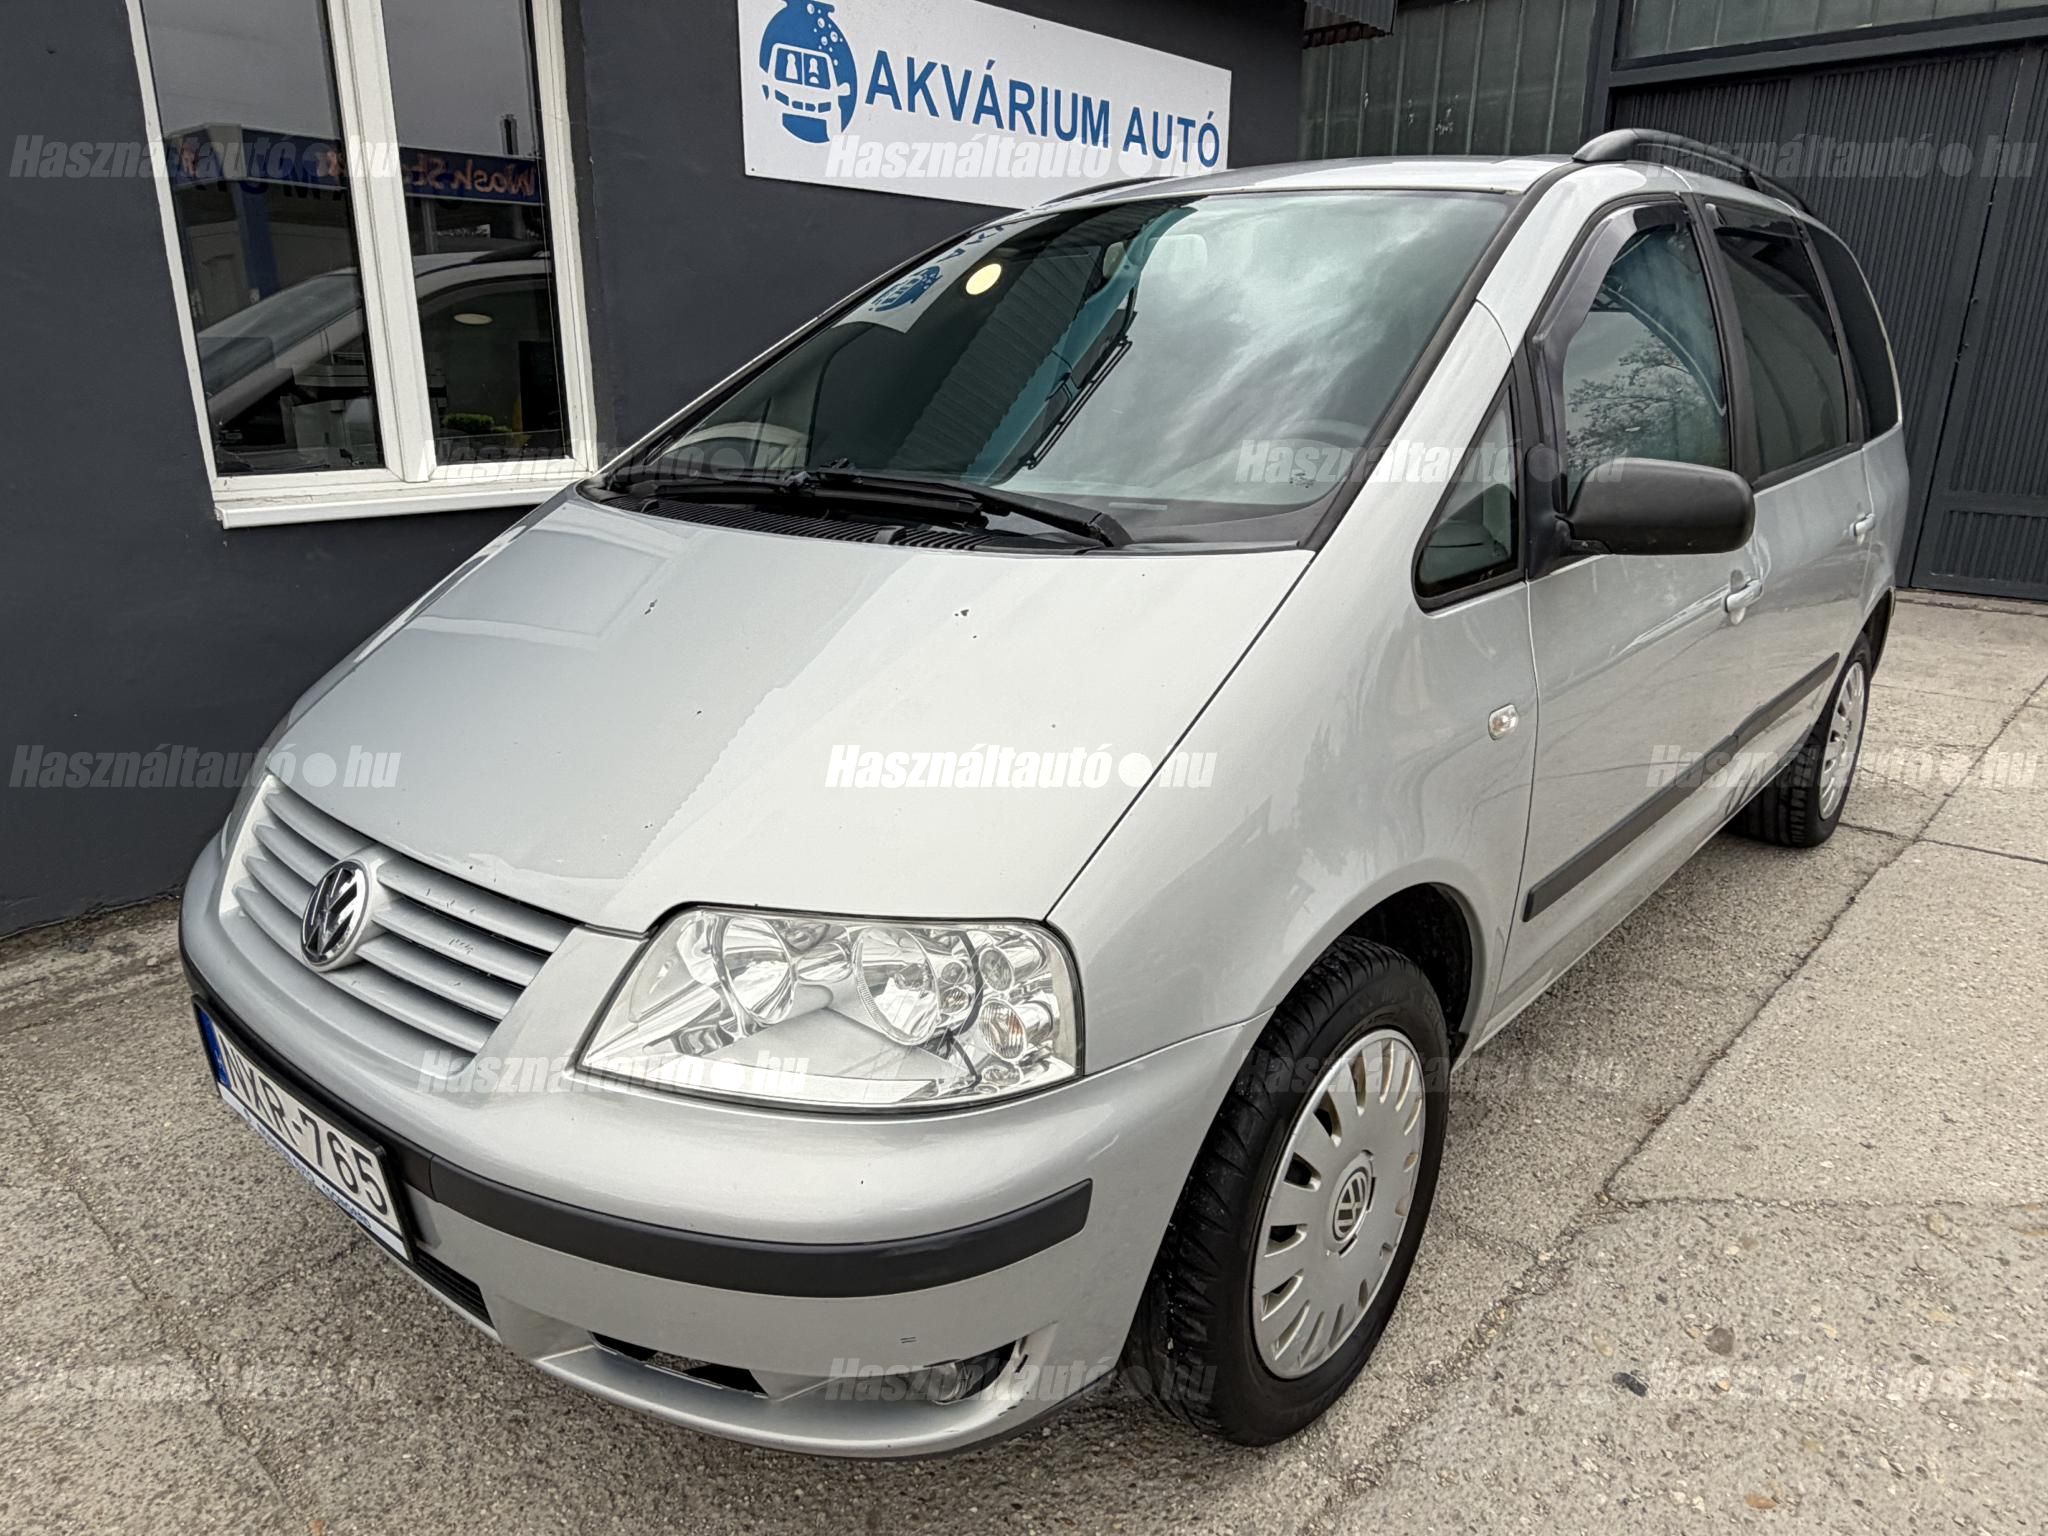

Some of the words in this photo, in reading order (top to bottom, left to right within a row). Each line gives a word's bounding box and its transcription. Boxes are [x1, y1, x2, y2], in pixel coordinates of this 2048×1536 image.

[865, 49, 1111, 149] AKVÁRIUM
[1122, 110, 1221, 168] AUTÓ
[218, 1033, 388, 1216] NXR-765
